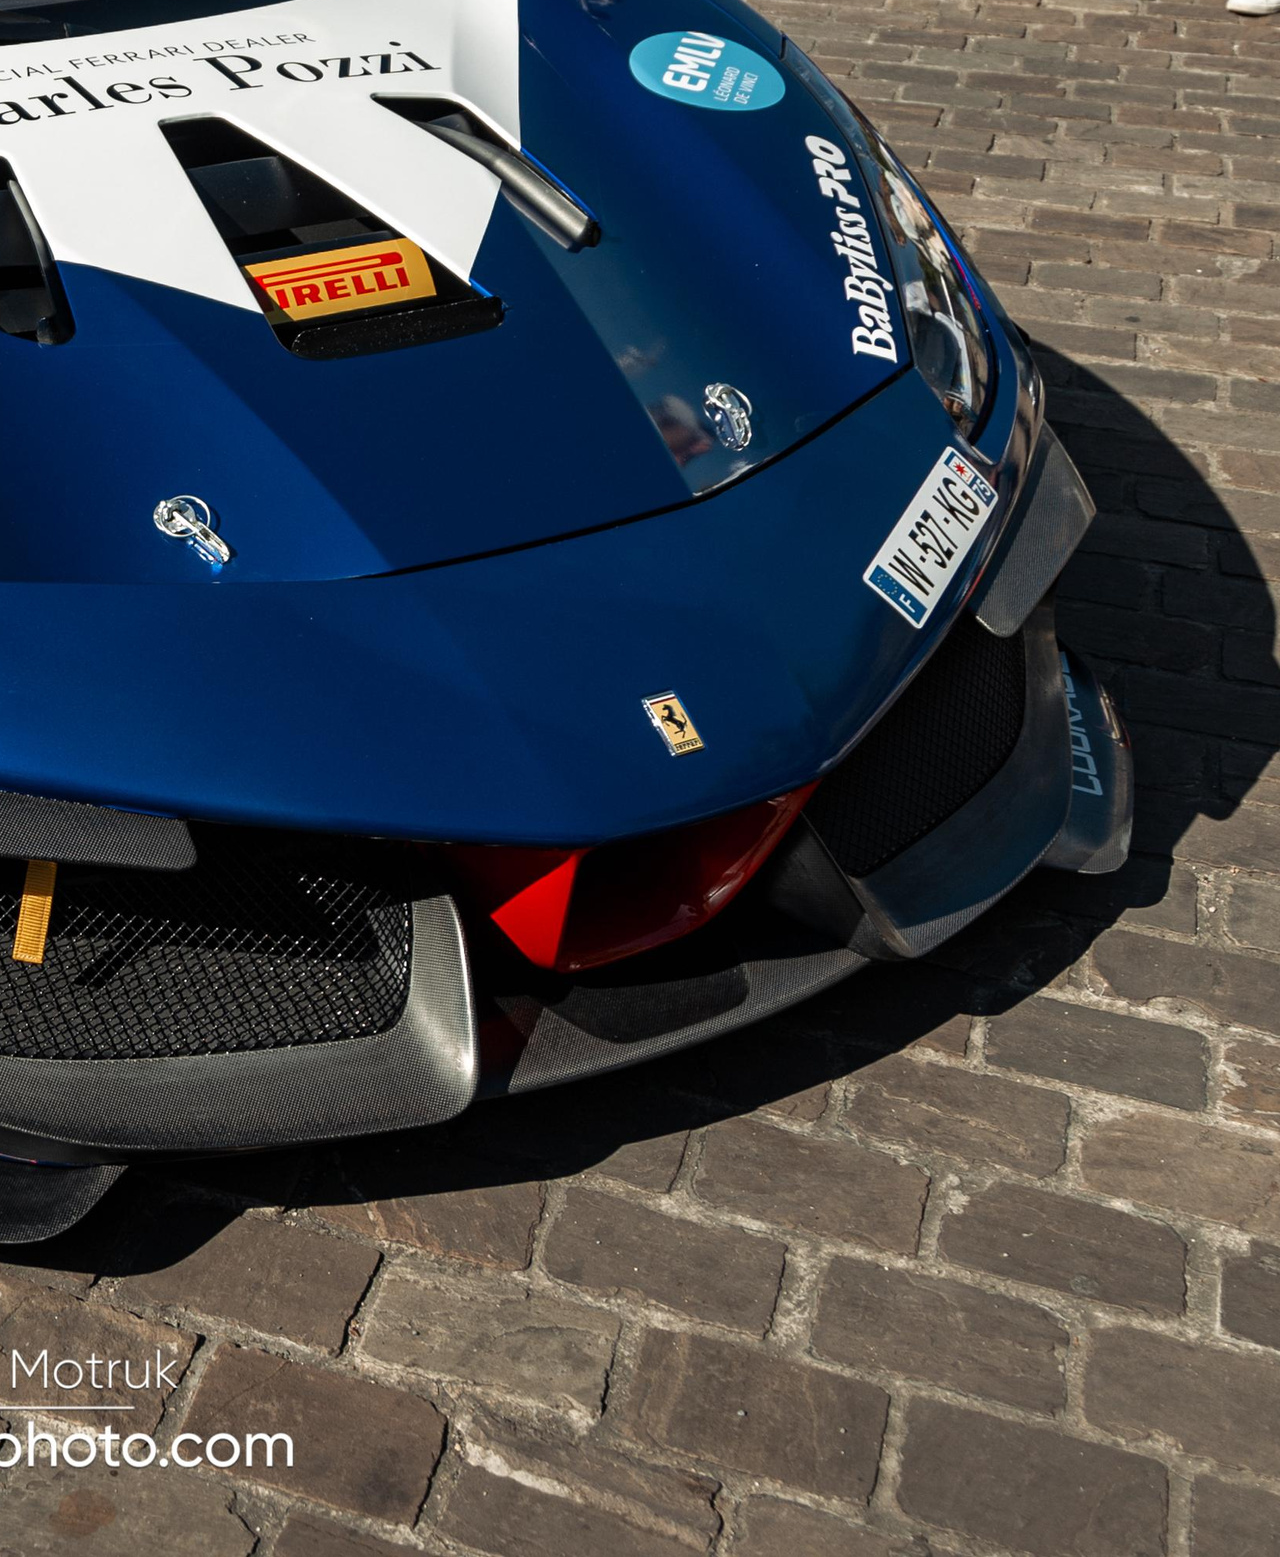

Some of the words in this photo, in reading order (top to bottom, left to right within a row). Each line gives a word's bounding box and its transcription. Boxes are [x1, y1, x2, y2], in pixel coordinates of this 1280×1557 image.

[69, 44, 195, 70] FERRARI
[203, 32, 315, 53] DEALER
[193, 41, 442, 91] Pozzi
[662, 31, 725, 92] EMLV
[713, 66, 740, 102] LÉONARD
[733, 92, 750, 104] DE
[740, 72, 758, 92] VINCI
[257, 251, 411, 313] PIRELLI
[899, 593, 916, 613] F
[972, 478, 992, 502] 75
